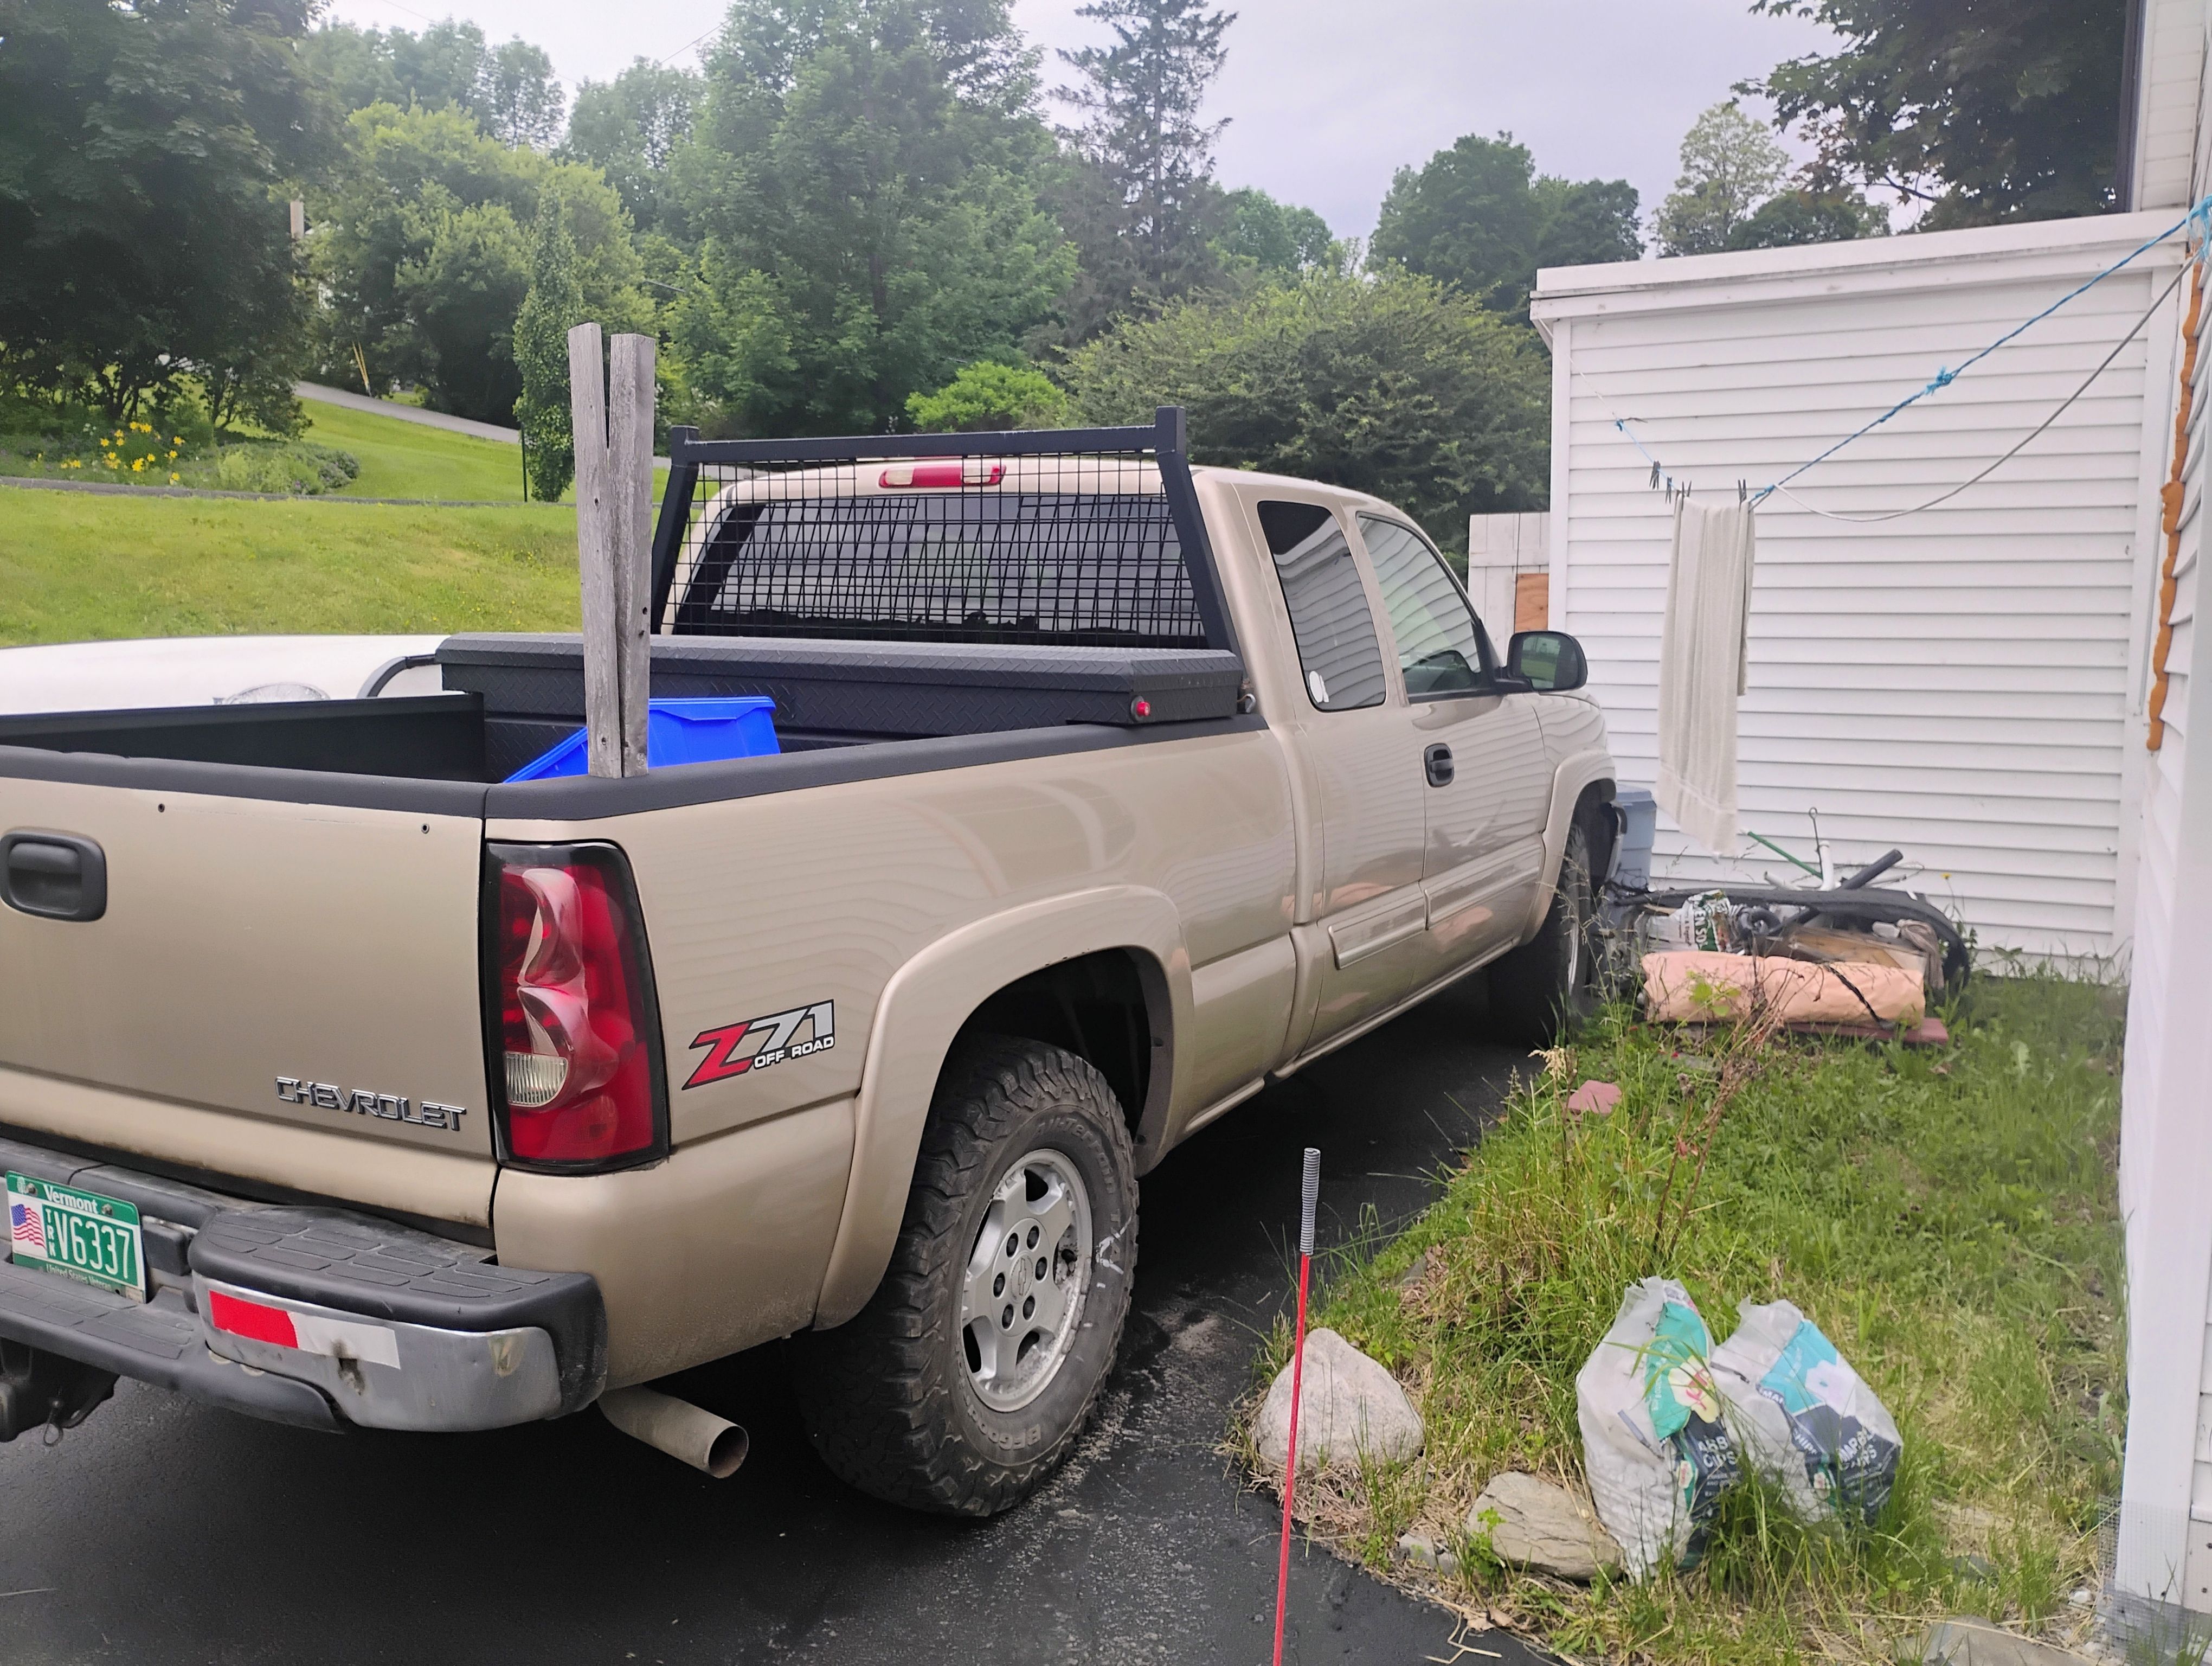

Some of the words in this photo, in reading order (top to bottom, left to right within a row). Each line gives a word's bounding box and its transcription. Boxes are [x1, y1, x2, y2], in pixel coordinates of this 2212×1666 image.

[681, 999, 834, 1091] Z71
[754, 1049, 785, 1068] OFF
[792, 1036, 834, 1058] ROAD
[275, 1076, 467, 1131] CHEVROLET
[43, 1184, 98, 1214] Vermont
[45, 1209, 56, 1257] TRK
[54, 1211, 130, 1279] V6337
